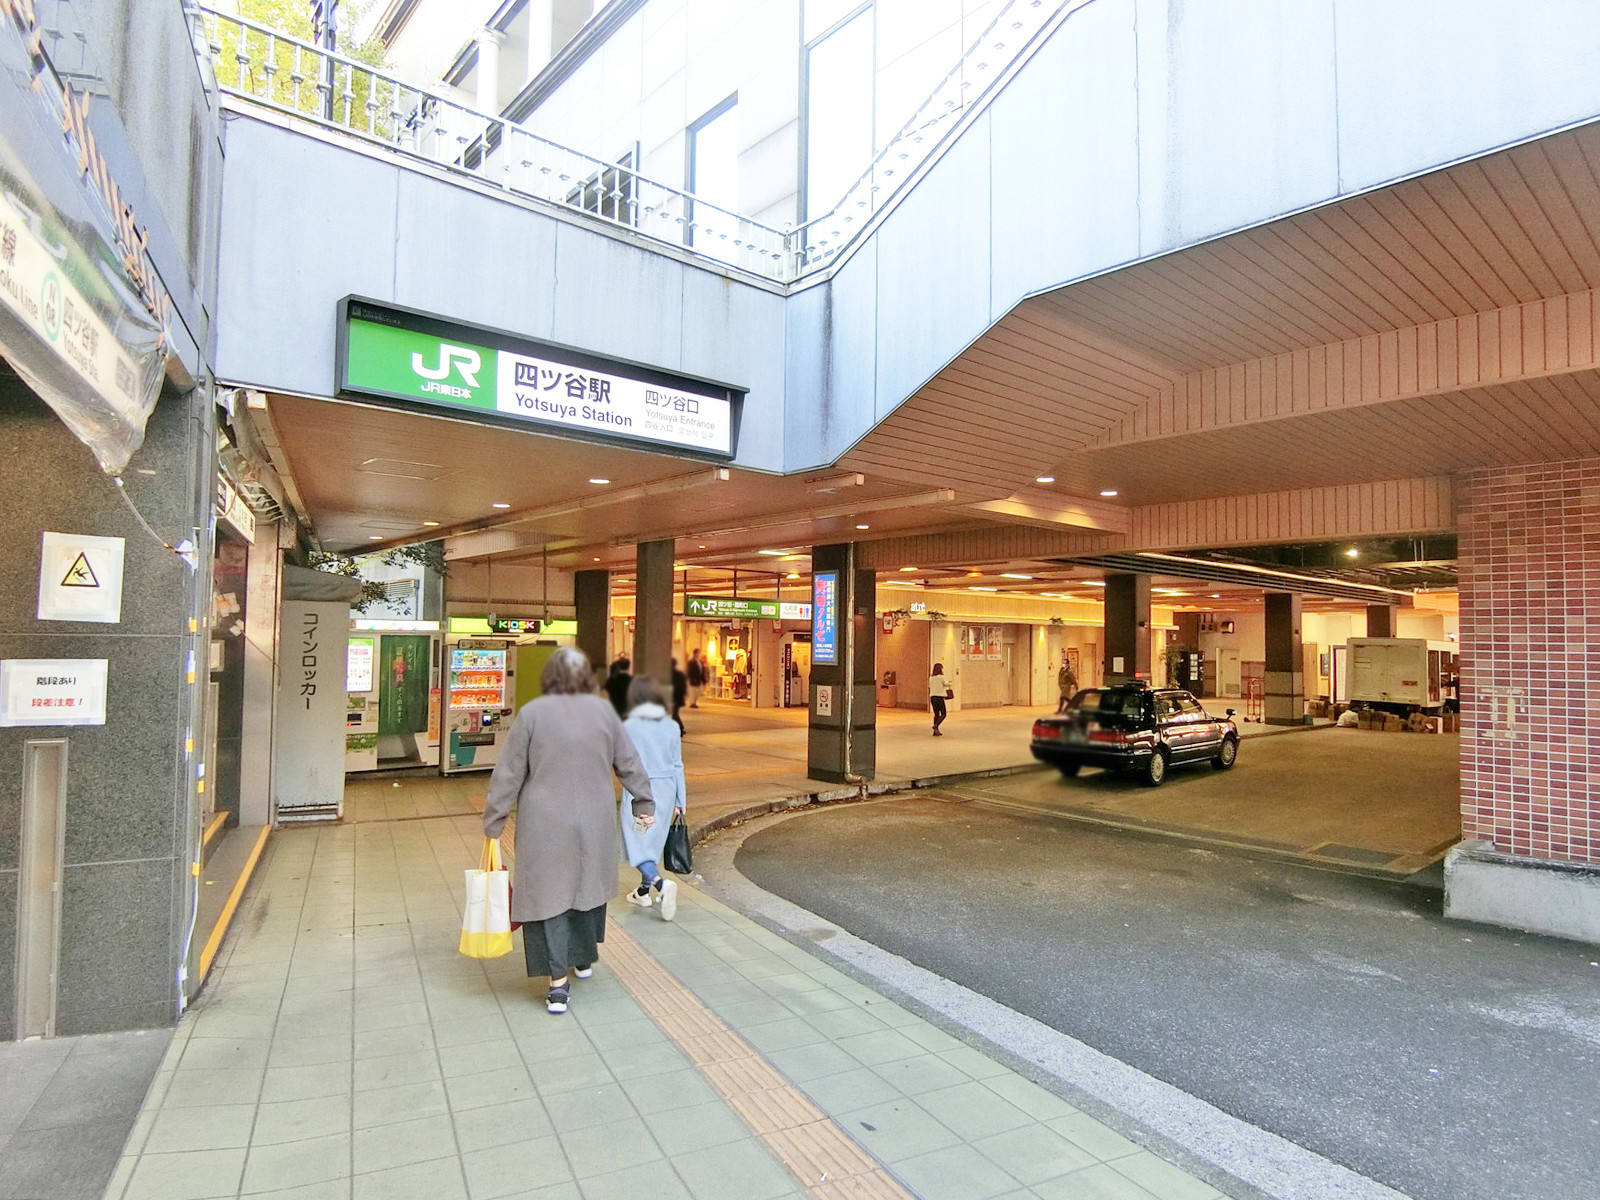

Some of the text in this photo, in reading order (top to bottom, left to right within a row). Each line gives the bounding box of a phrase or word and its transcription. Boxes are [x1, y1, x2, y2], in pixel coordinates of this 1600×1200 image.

[20, 285, 38, 320] Line
[46, 301, 56, 328] 08
[64, 296, 99, 357] 四ツ谷駅
[63, 331, 88, 372] Yotsuya
[412, 343, 481, 389] JR
[420, 381, 472, 399] JR東日本
[514, 362, 611, 404] 四ツ谷駅
[515, 393, 632, 427] Yotsuya Station
[645, 390, 699, 414] 四ツ谷口
[645, 408, 716, 430] Yotsuya Entrance
[701, 600, 718, 612] JR
[498, 620, 535, 630] KIOSK
[300, 613, 319, 710] コインロッカー
[36, 677, 77, 686] 階段あり
